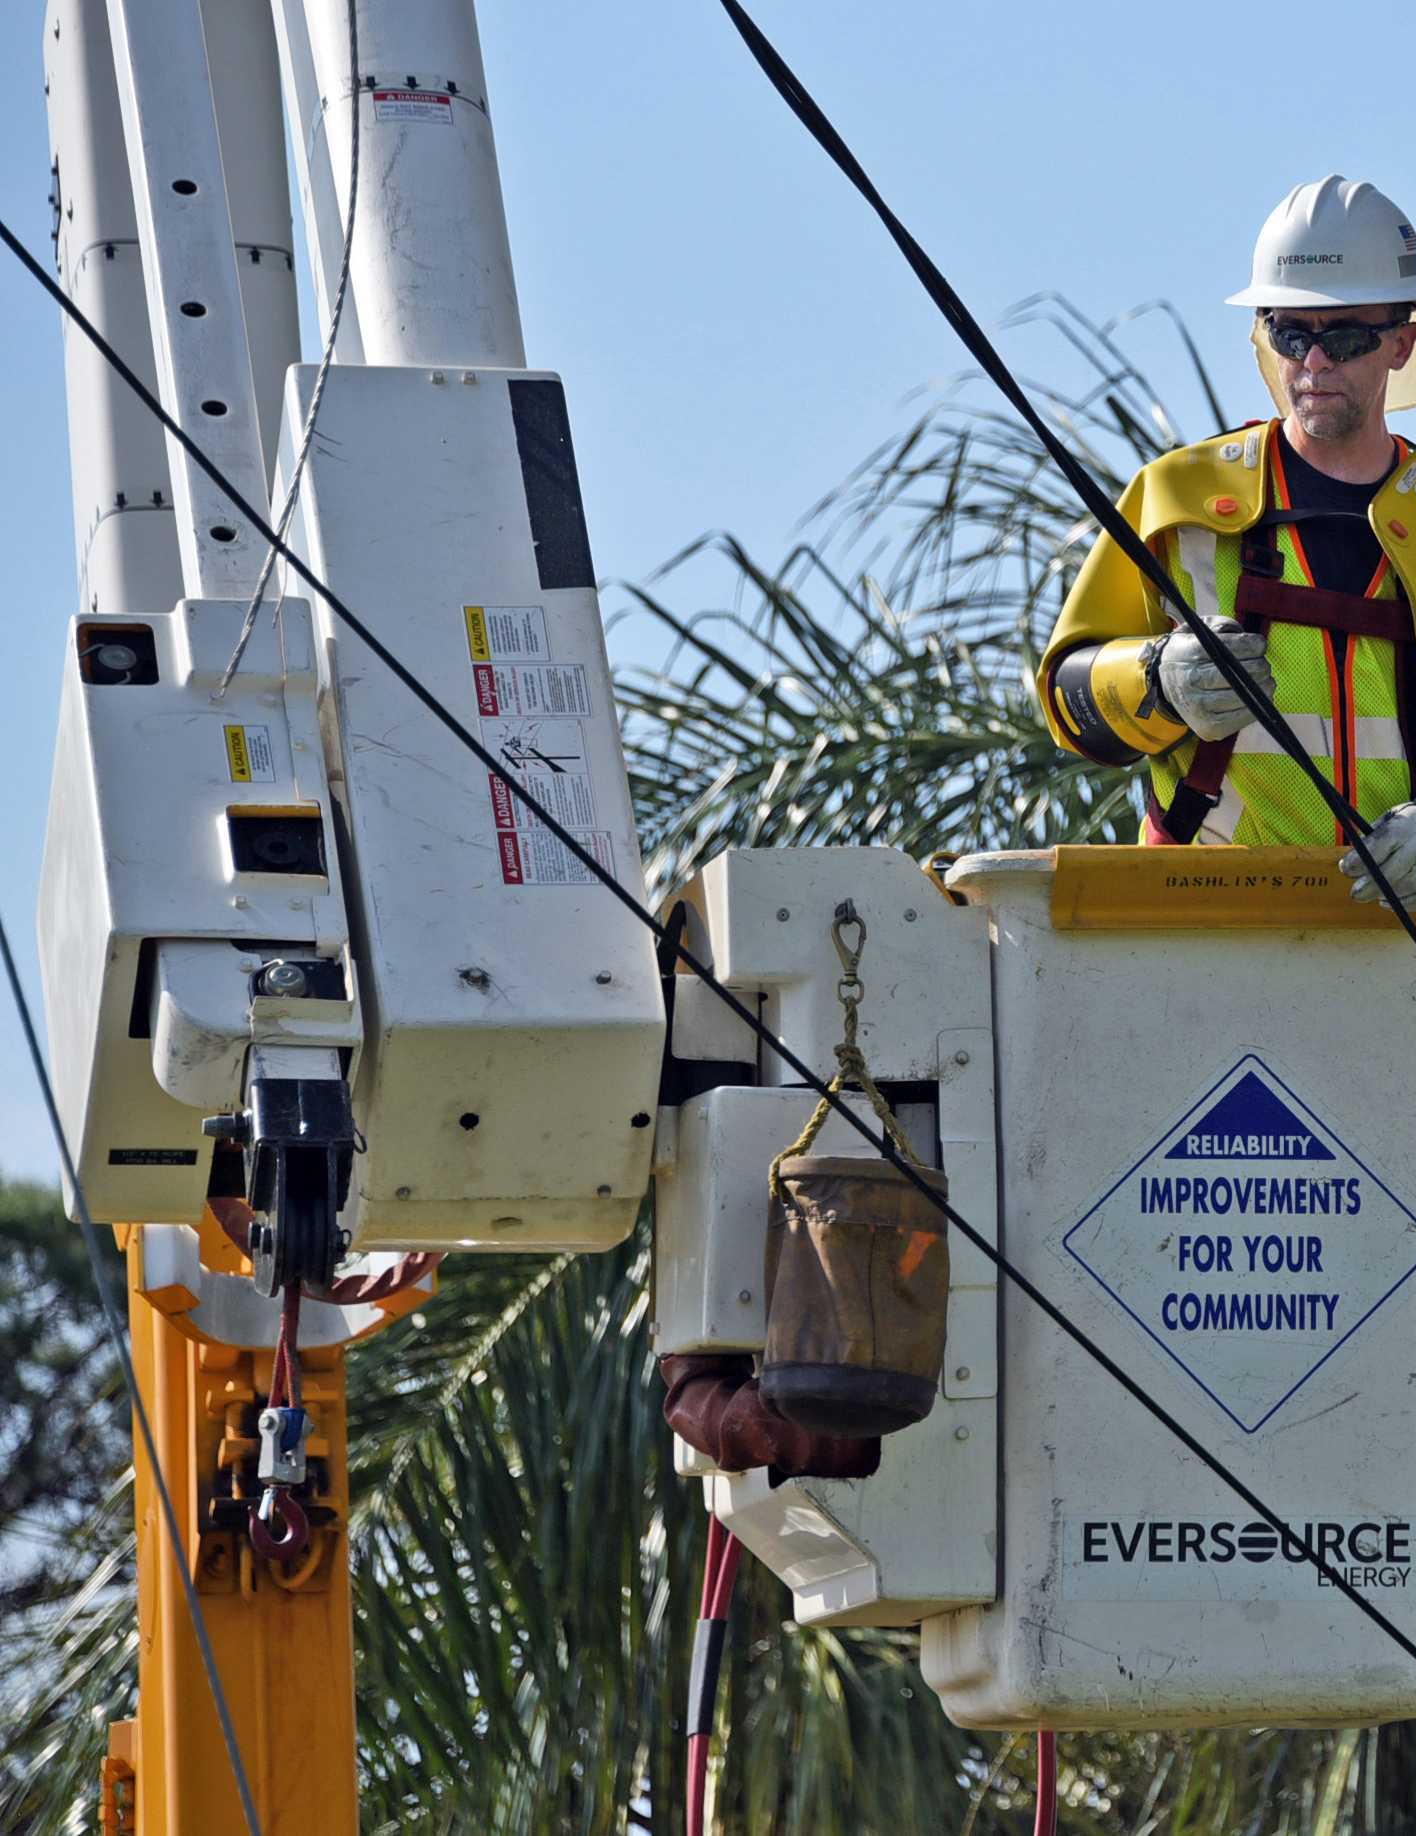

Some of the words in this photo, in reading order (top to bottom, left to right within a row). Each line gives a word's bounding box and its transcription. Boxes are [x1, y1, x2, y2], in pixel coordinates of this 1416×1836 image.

[1277, 254, 1344, 265] EVERSOURCE
[471, 613, 485, 647] CAUTION
[478, 669, 493, 705] DANGER
[231, 731, 245, 767] CAUTION
[503, 837, 517, 869] DANGER
[1186, 1134, 1312, 1156] RELIABILITY
[1140, 1176, 1361, 1216] IMPROVEMENTS
[1178, 1235, 1233, 1273] FOR
[1243, 1235, 1323, 1273] YOUR
[1161, 1292, 1340, 1331] COMMUNITY
[1083, 1521, 1411, 1563] EVERSOURCE
